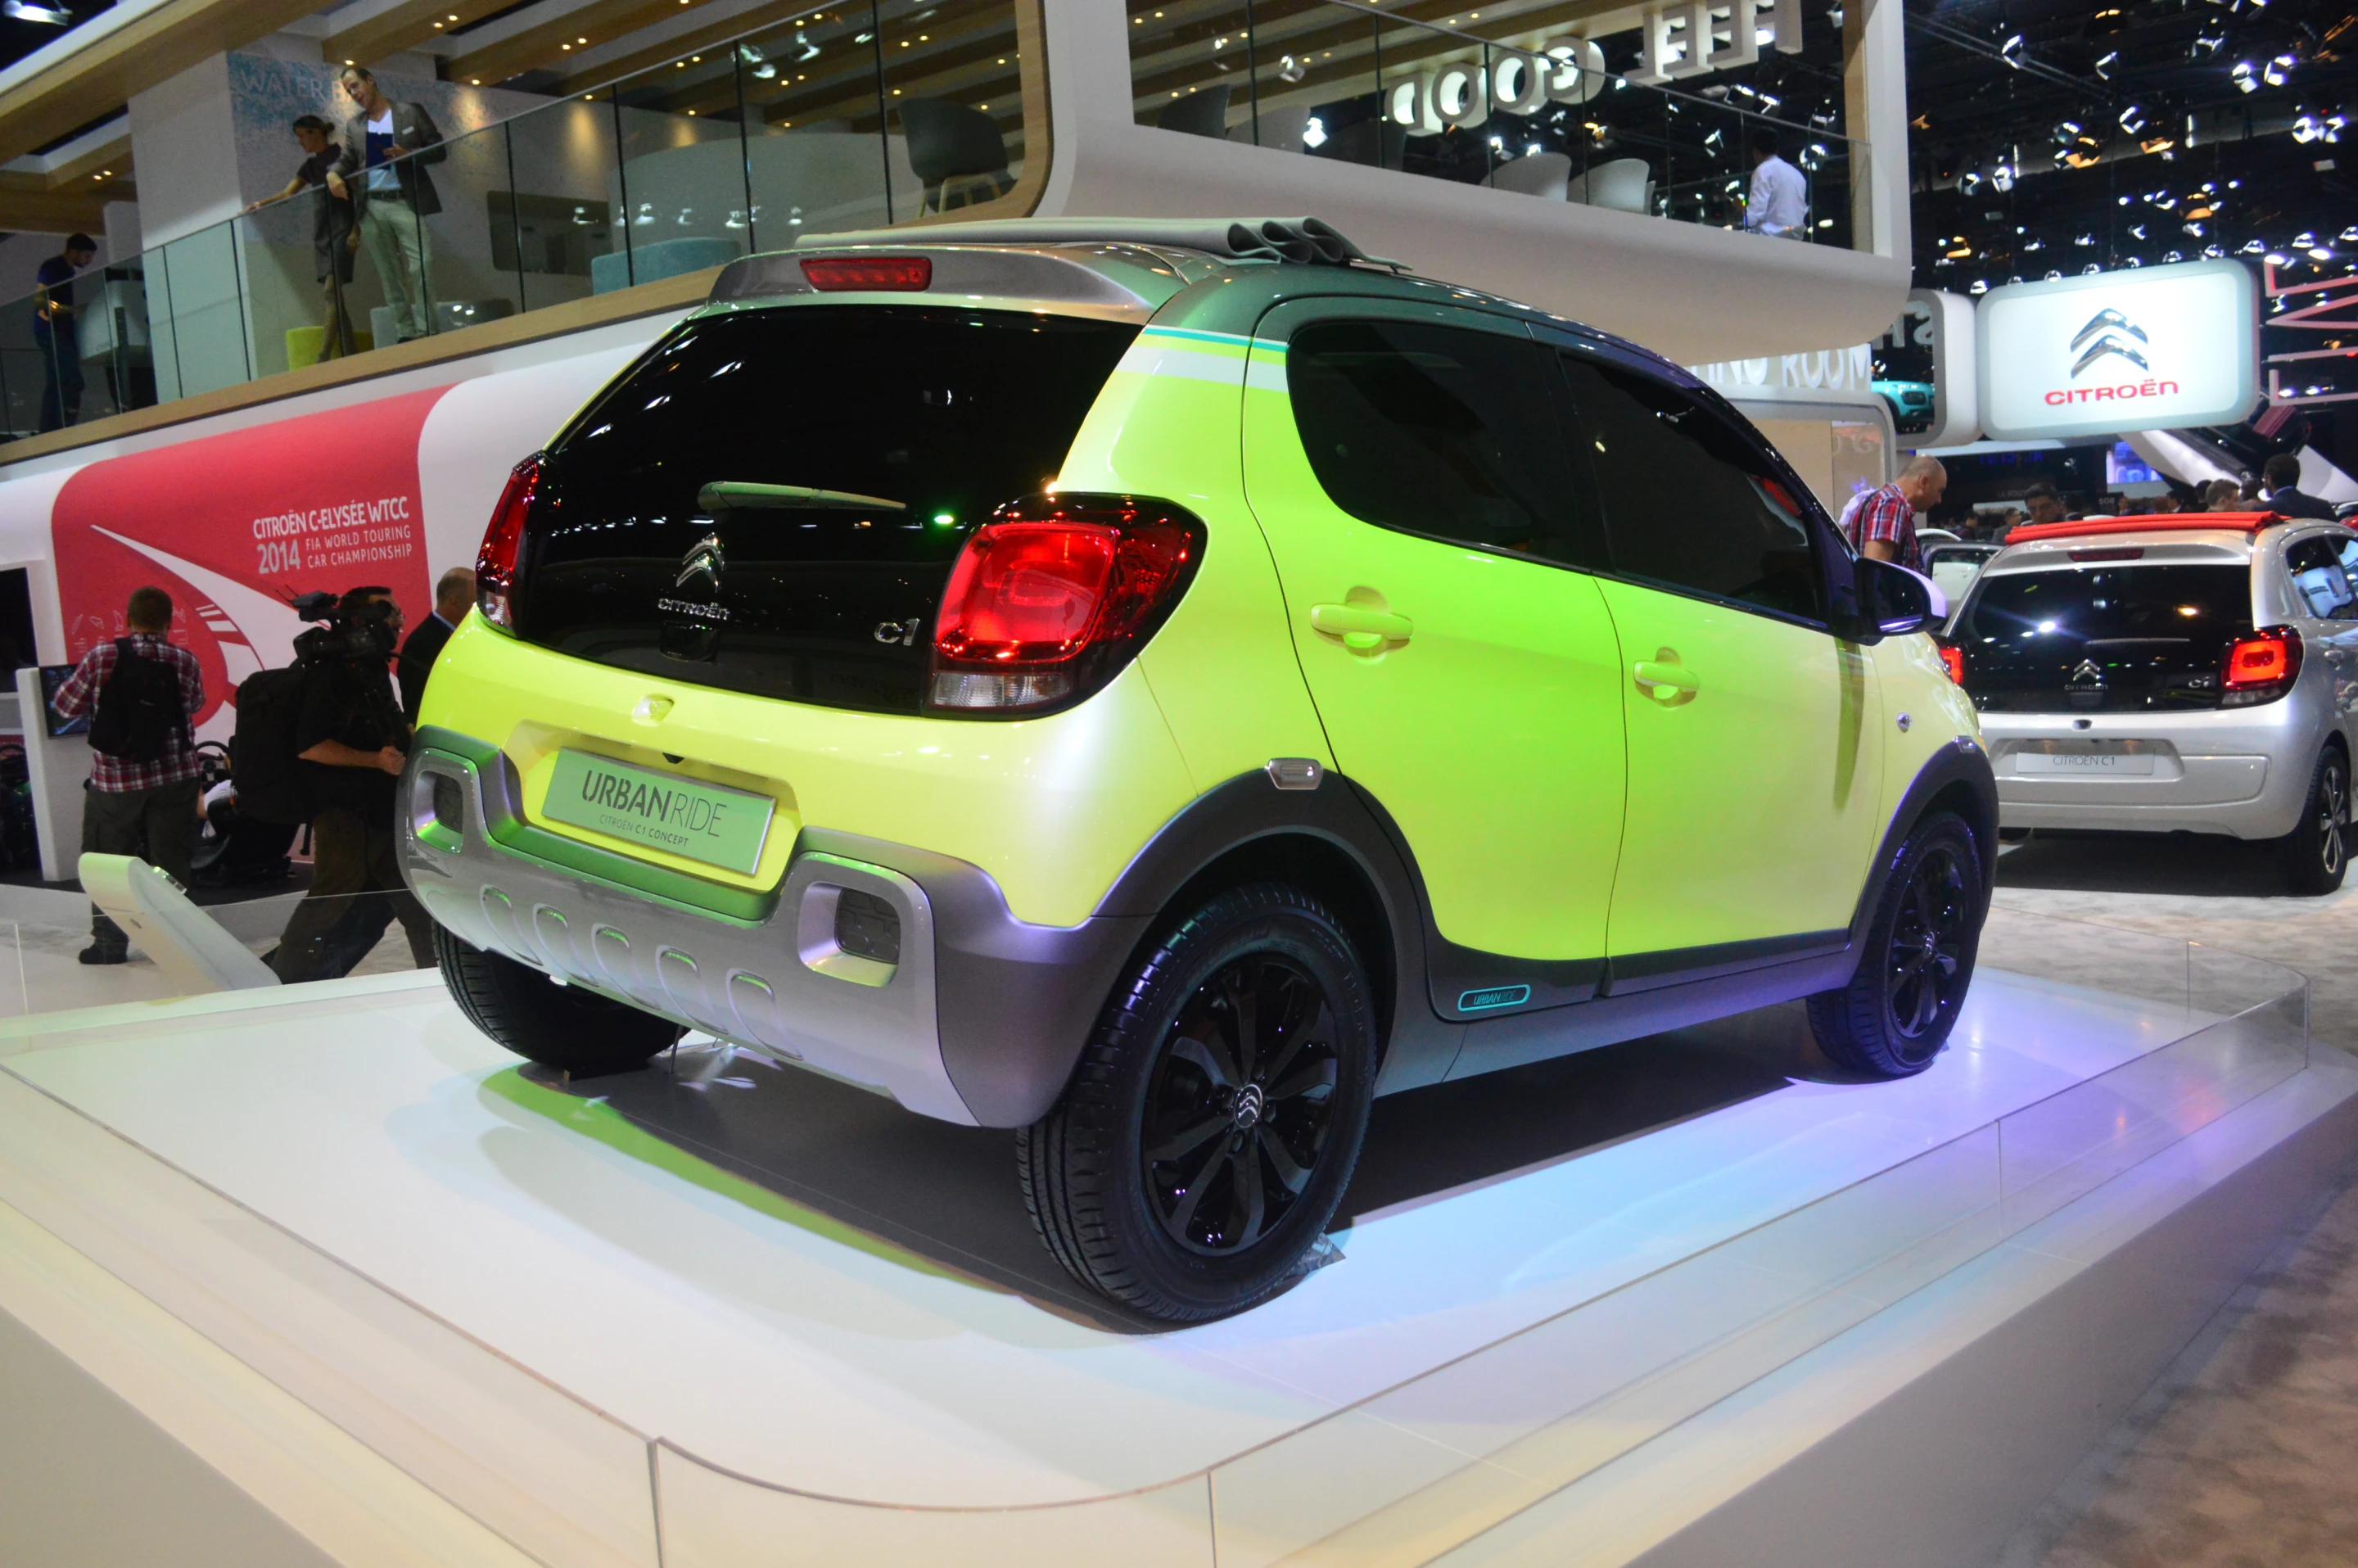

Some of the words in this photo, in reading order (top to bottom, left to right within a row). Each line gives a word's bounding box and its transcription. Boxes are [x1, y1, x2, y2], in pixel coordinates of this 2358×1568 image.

[240, 69, 326, 102] WATER
[253, 509, 307, 540] CITROËN
[309, 499, 366, 531] C-ELYSÉE
[367, 495, 409, 523] WTCC
[305, 538, 322, 550] FIA
[324, 532, 359, 549] WORLD
[364, 525, 411, 544] TOURING
[256, 539, 300, 574] 2014
[307, 555, 328, 568] CAR
[331, 543, 412, 566] CHAMPIONSHIP
[874, 617, 920, 646] C1
[2101, 755, 2116, 766] C1
[599, 814, 635, 832] CITROËN
[635, 824, 648, 835] C1
[648, 827, 689, 848] CONCEPT
